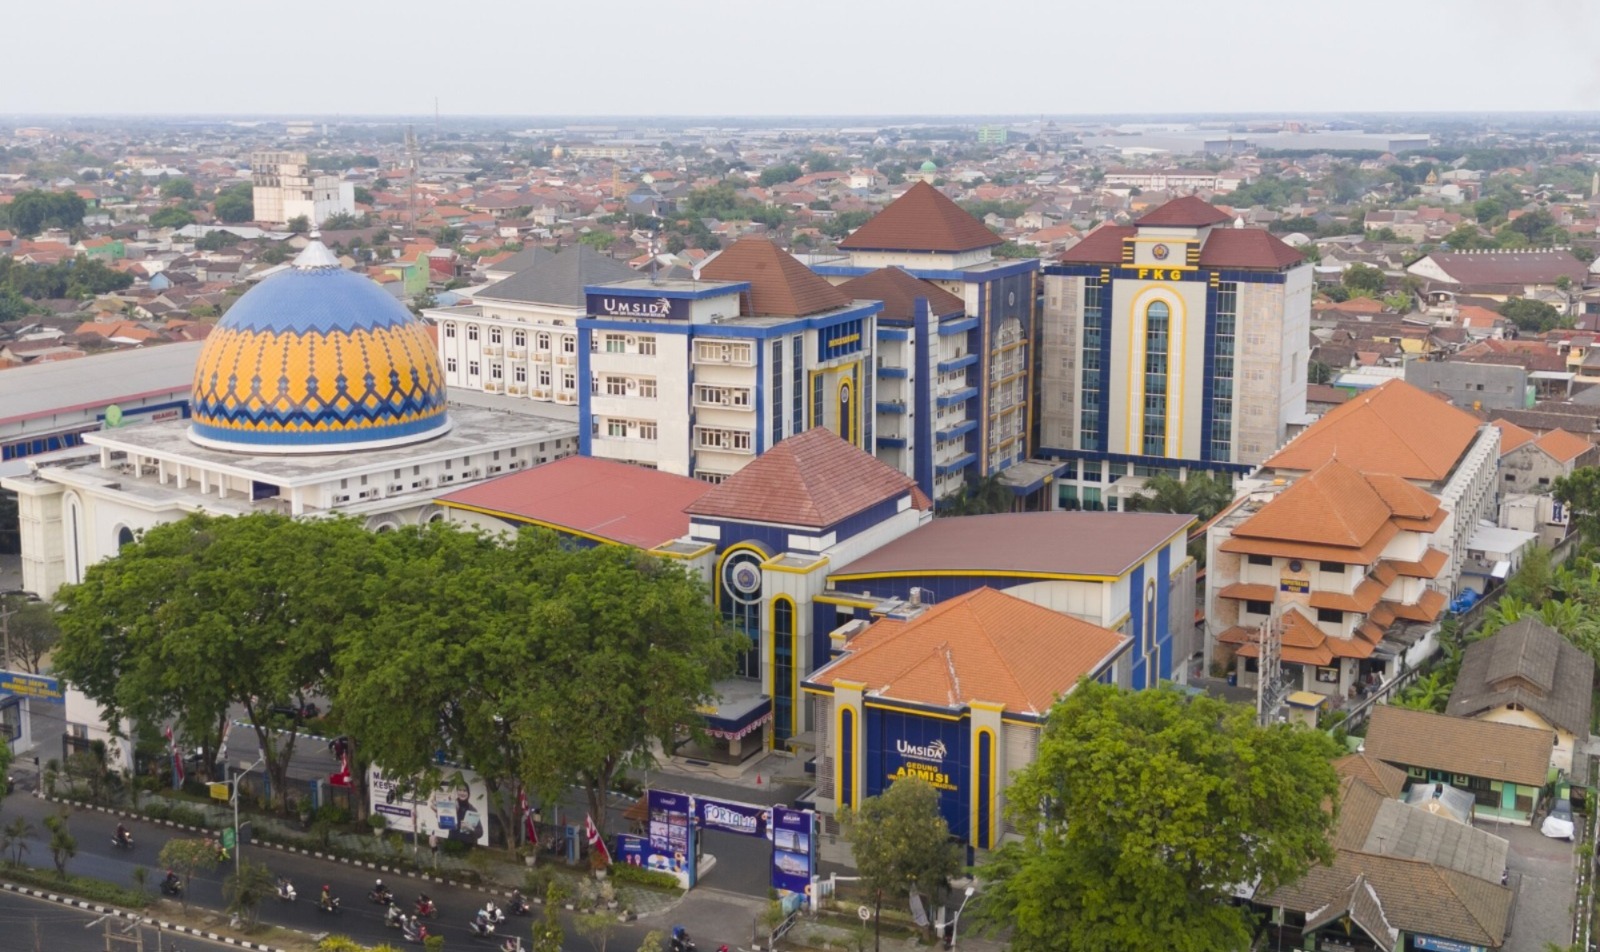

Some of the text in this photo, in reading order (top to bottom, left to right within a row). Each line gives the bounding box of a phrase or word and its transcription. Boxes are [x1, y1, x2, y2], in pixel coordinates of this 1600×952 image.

[1138, 269, 1181, 281] FKG
[603, 298, 670, 315] UMSIDA
[896, 739, 943, 759] UMSIDA
[897, 766, 949, 784] ADMISI
[906, 761, 938, 772] GEDUNG
